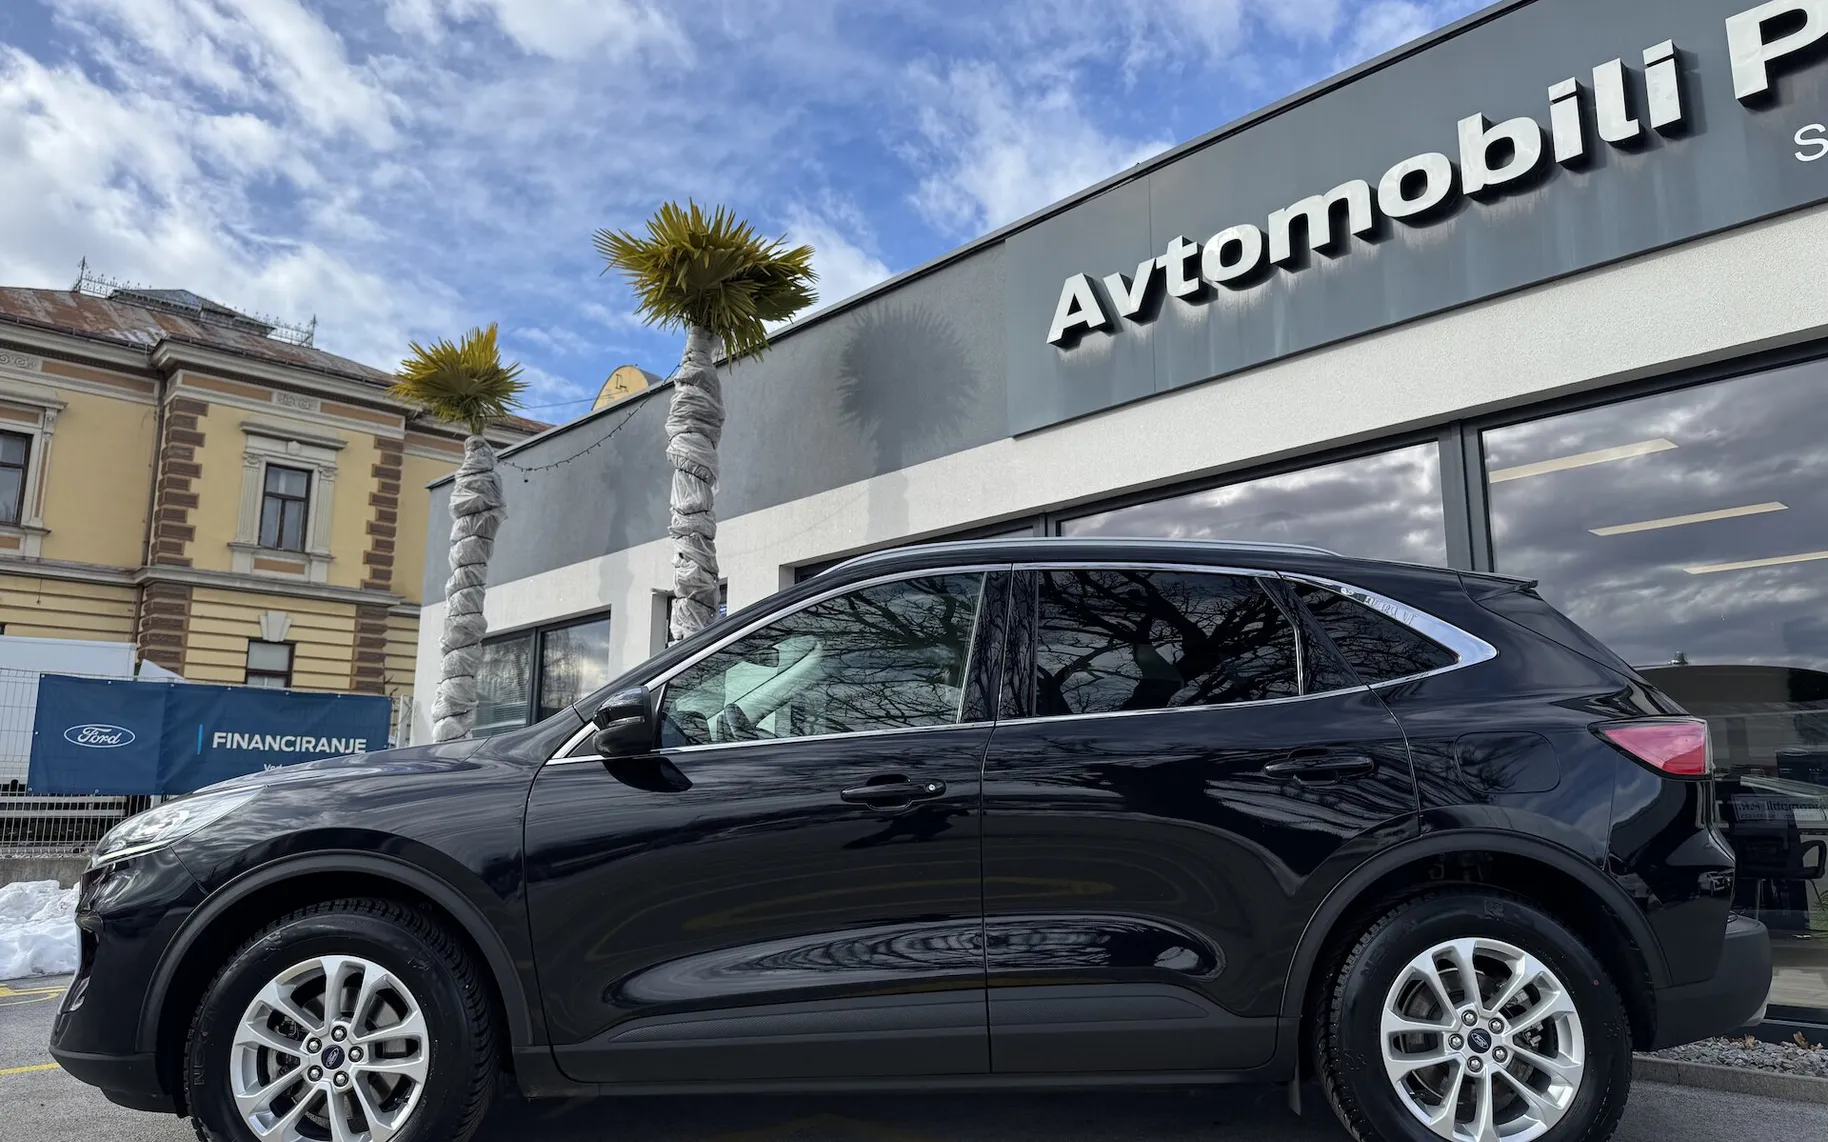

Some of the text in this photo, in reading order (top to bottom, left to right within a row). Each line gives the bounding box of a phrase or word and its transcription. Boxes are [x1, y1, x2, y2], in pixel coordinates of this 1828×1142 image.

[1046, 39, 1684, 345] Avtomobili
[77, 726, 122, 745] Ford
[212, 731, 367, 754] FINANCIRANJE
